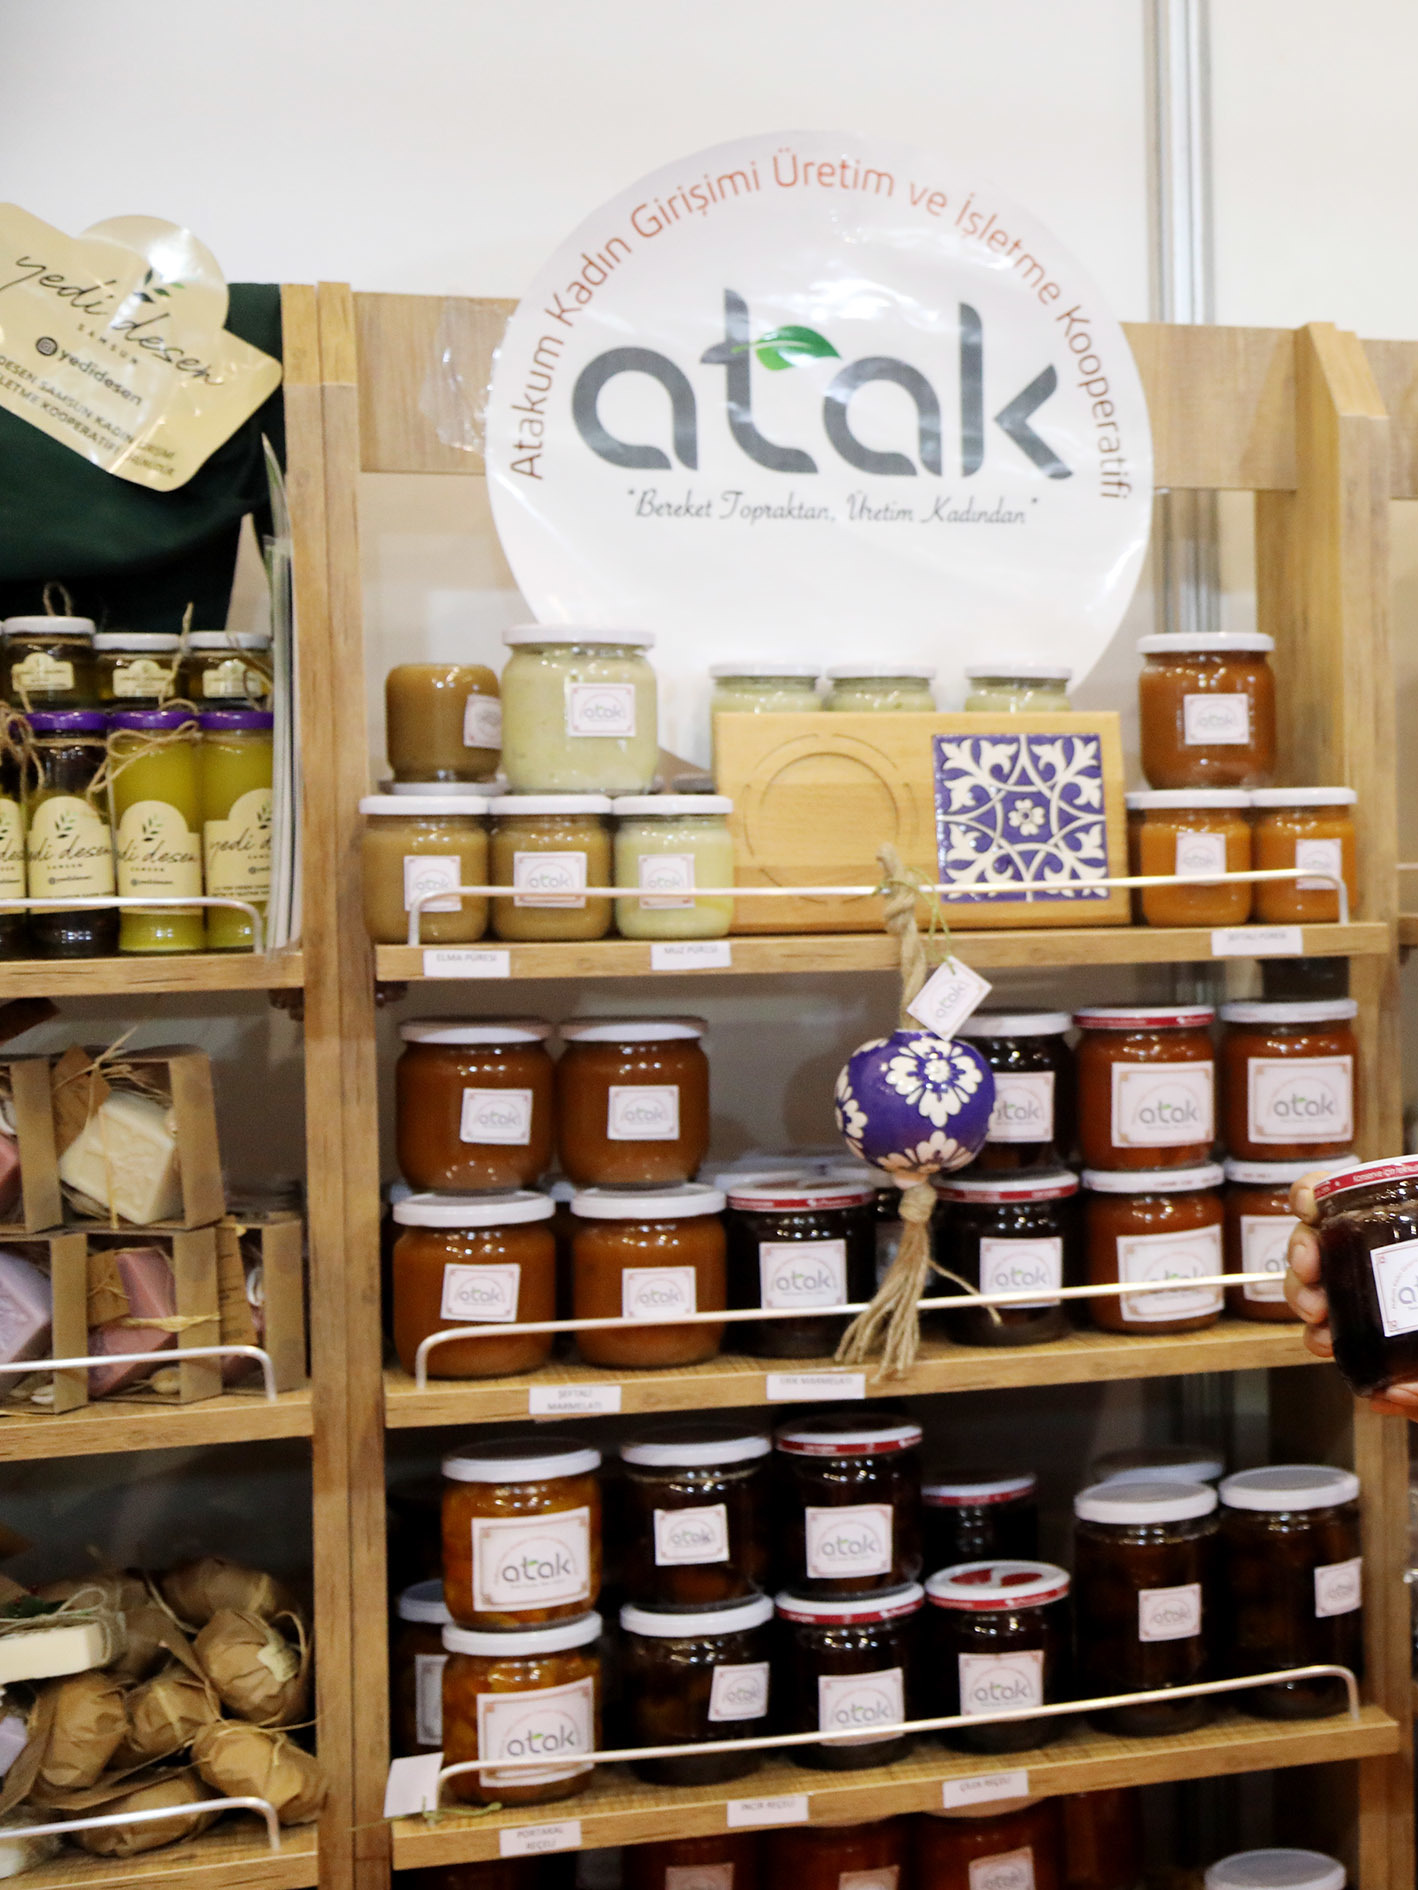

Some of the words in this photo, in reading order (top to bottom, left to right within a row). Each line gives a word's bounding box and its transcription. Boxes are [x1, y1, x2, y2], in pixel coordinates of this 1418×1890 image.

[511, 335, 564, 481] Atakum
[545, 236, 632, 327] Kadın
[631, 161, 760, 238] Girişimi
[773, 148, 895, 197] Üretim
[909, 182, 948, 216] ve
[955, 193, 1060, 305] İşletme
[1056, 305, 1132, 498] Kooperatifi
[111, 313, 225, 386] desen
[59, 350, 142, 407] yedidesen
[572, 287, 1073, 480] atak
[997, 1100, 1040, 1121] tak
[1139, 1098, 1198, 1124] atak
[1272, 1092, 1335, 1118] atak
[501, 1551, 572, 1584] atak
[506, 1724, 577, 1757] atak
